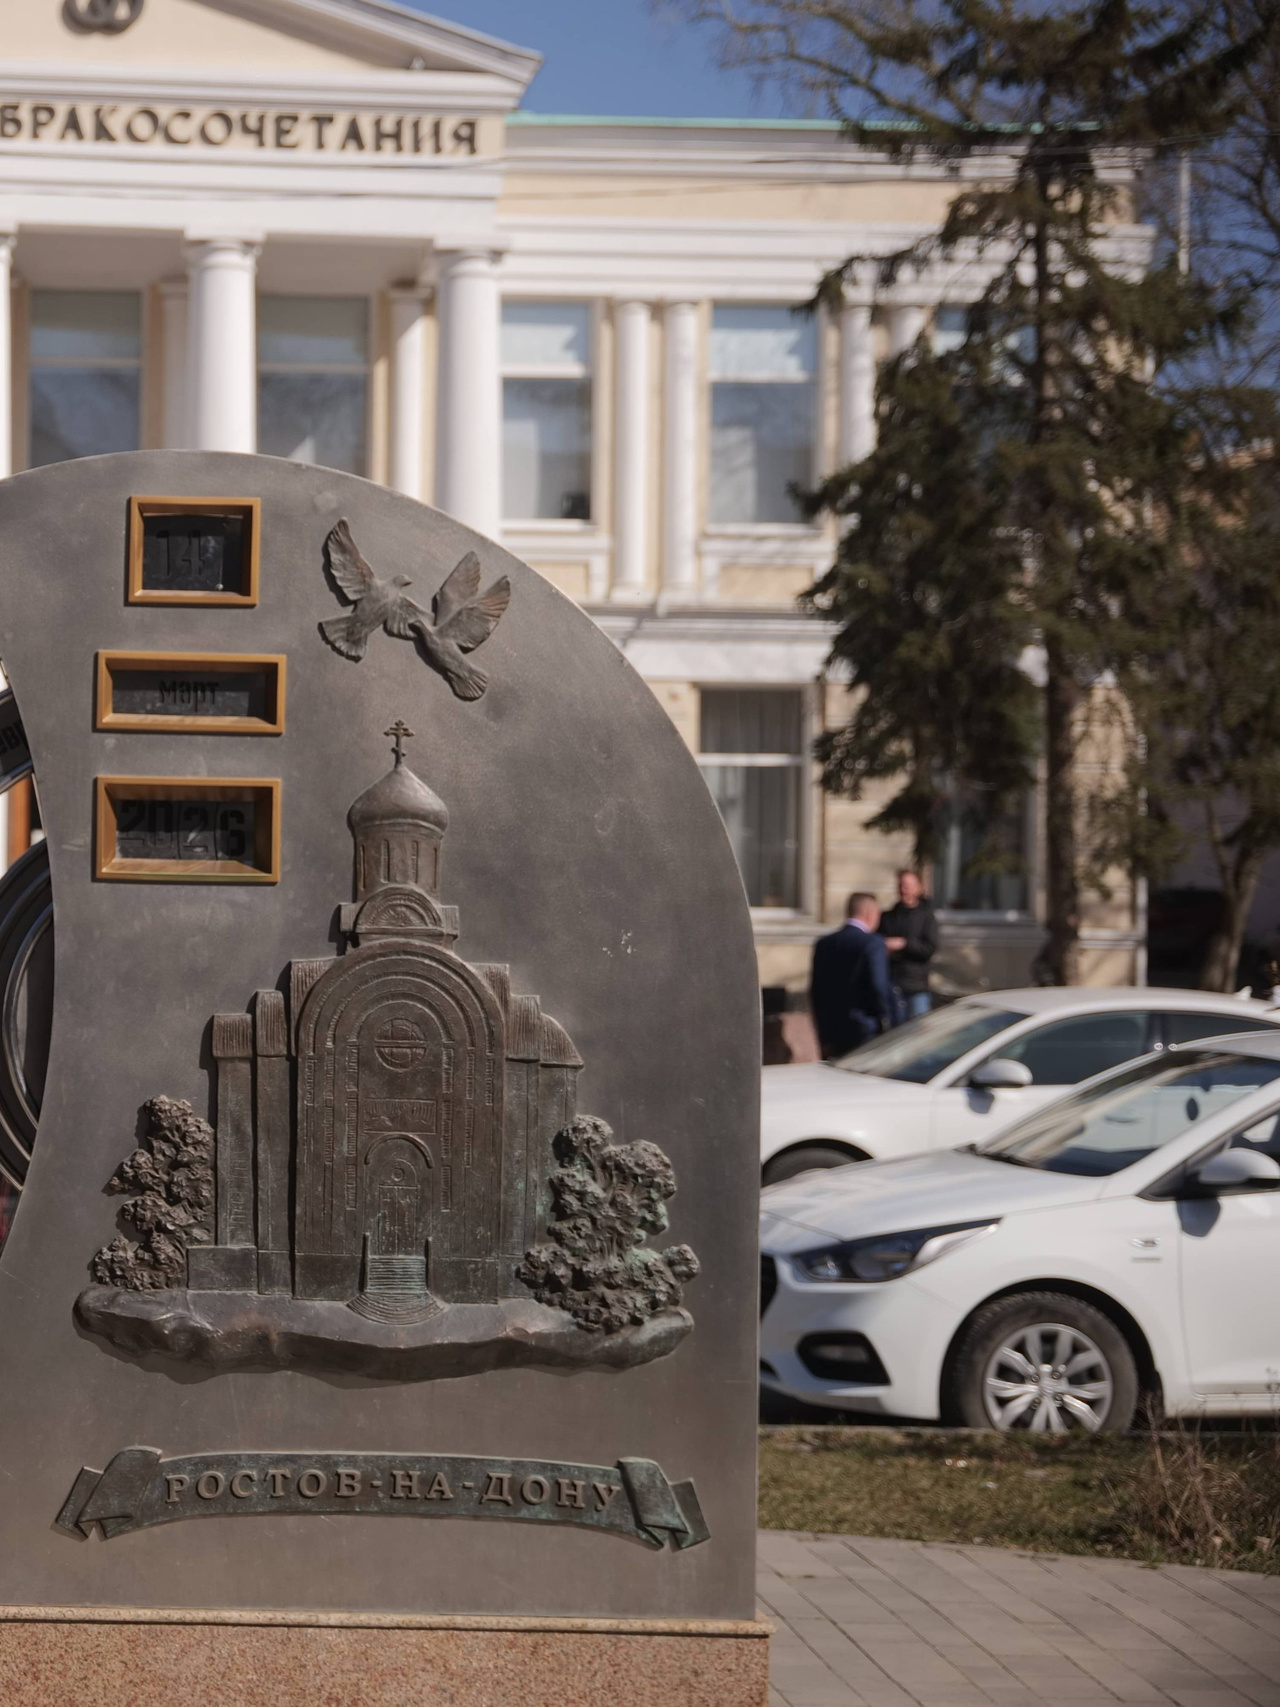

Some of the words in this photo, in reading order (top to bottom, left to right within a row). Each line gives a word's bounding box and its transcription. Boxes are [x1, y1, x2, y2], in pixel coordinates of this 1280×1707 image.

[156, 529, 205, 576] 14
[118, 800, 246, 857] 2026
[165, 1468, 622, 1511] РОСТОВ-НА-ДОНУ
